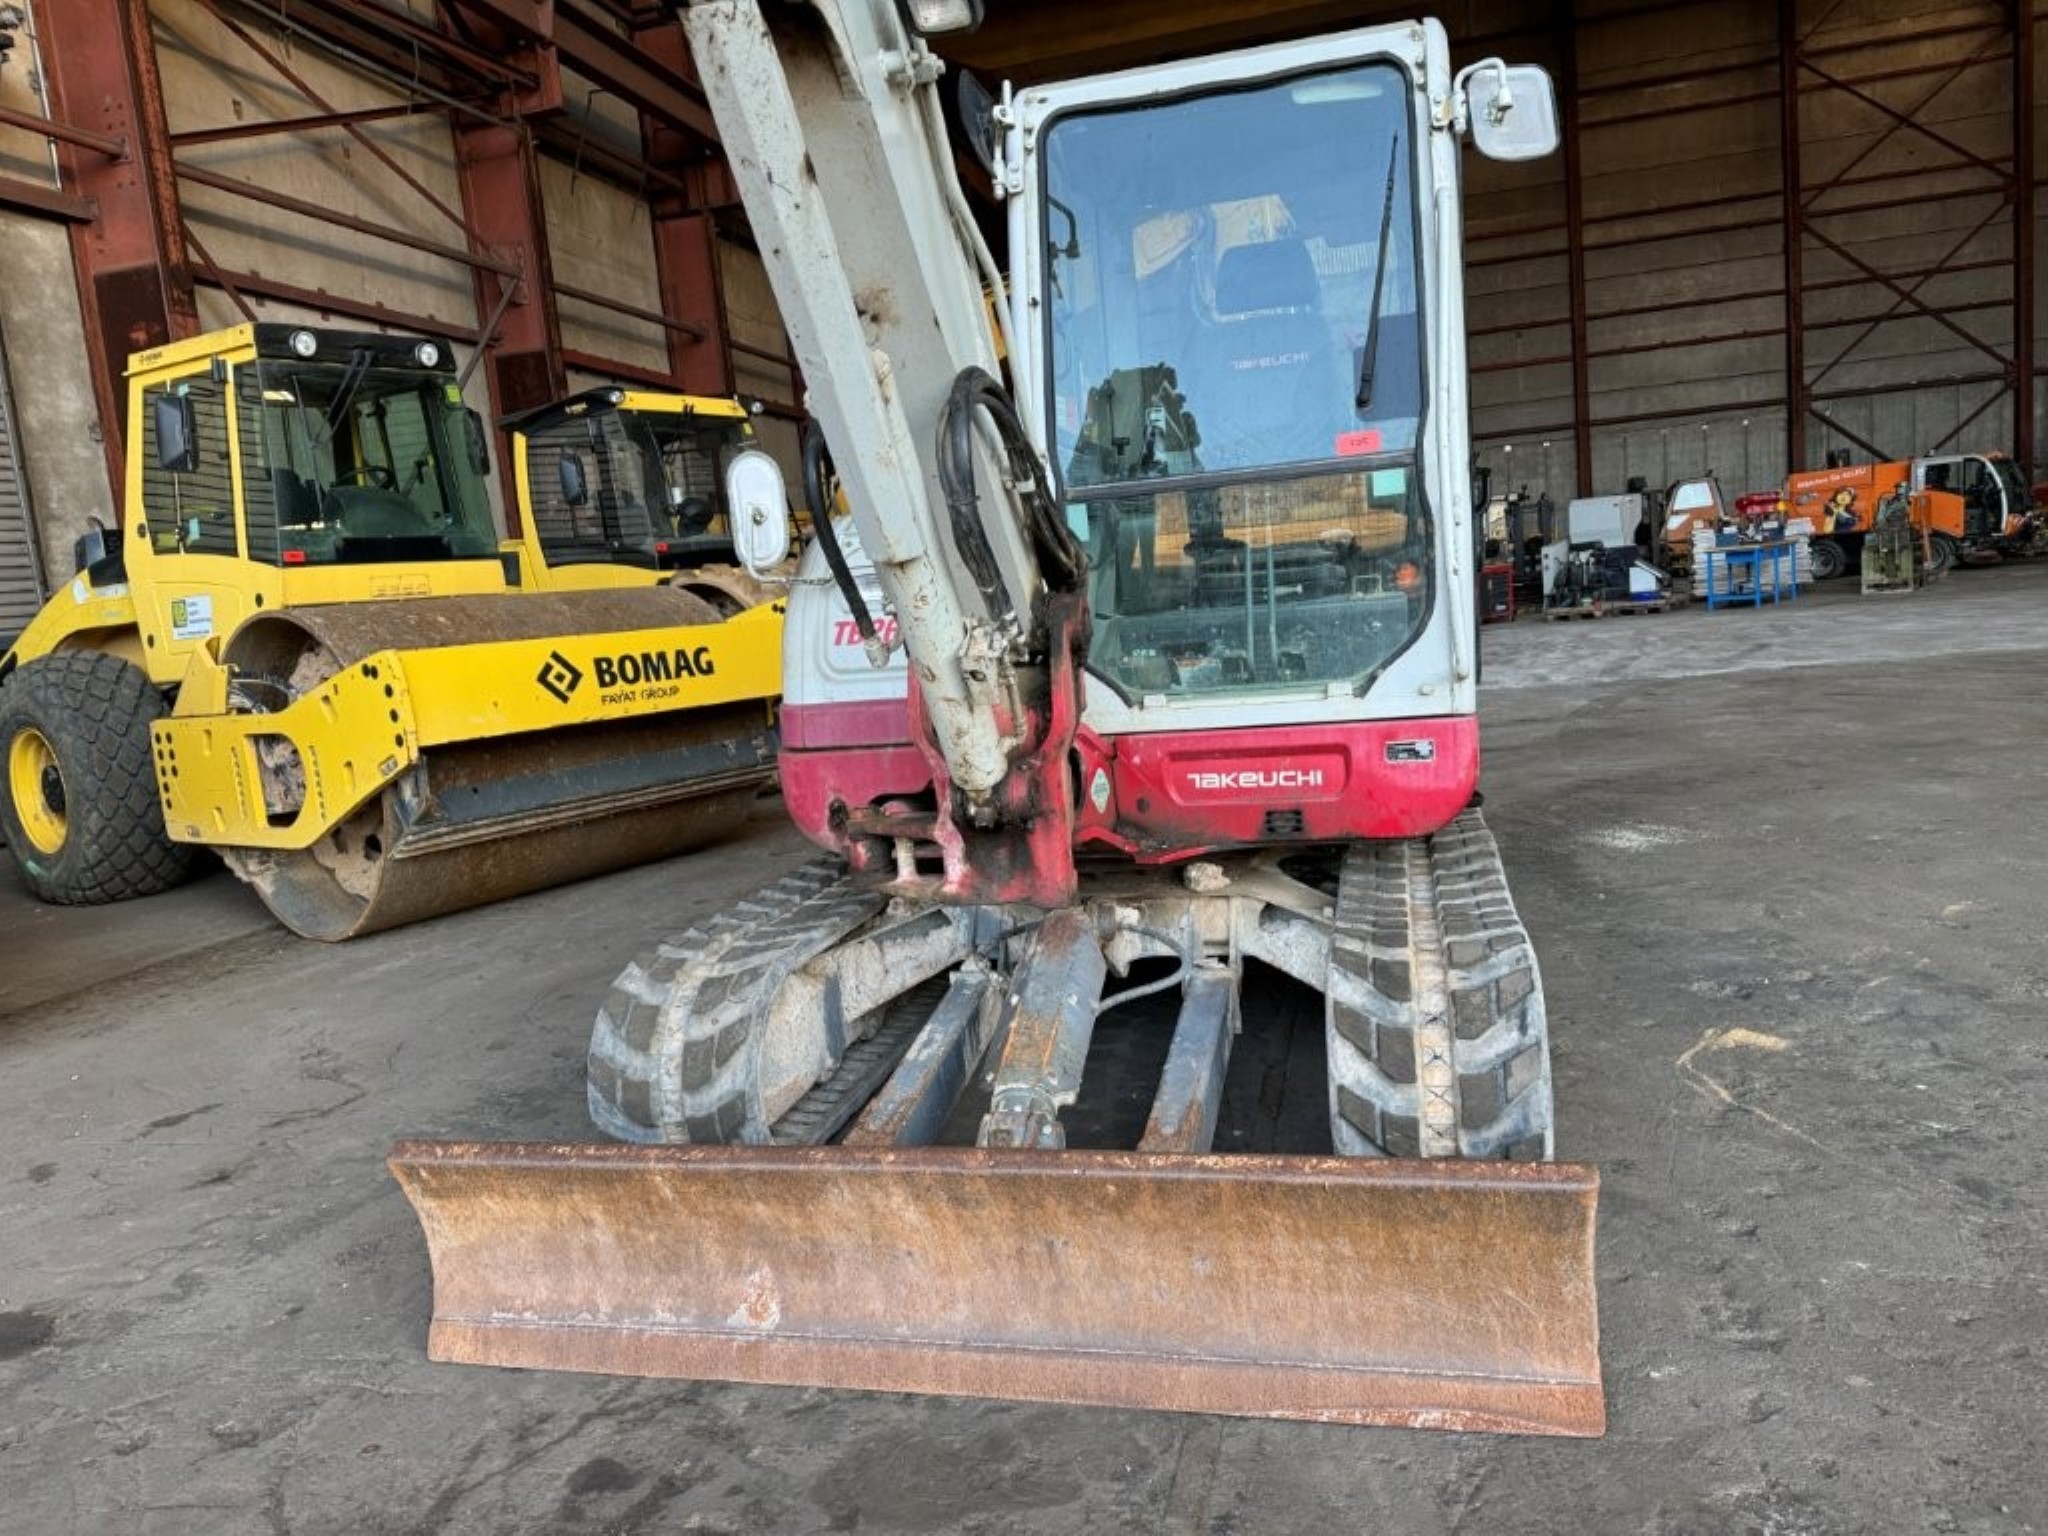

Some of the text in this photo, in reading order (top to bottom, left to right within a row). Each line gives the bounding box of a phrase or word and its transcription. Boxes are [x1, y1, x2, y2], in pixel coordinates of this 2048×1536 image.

[594, 647, 714, 688] BOMAG
[601, 685, 680, 706] FAYAT GROUP
[1187, 769, 1323, 789] TAKEUCHI
